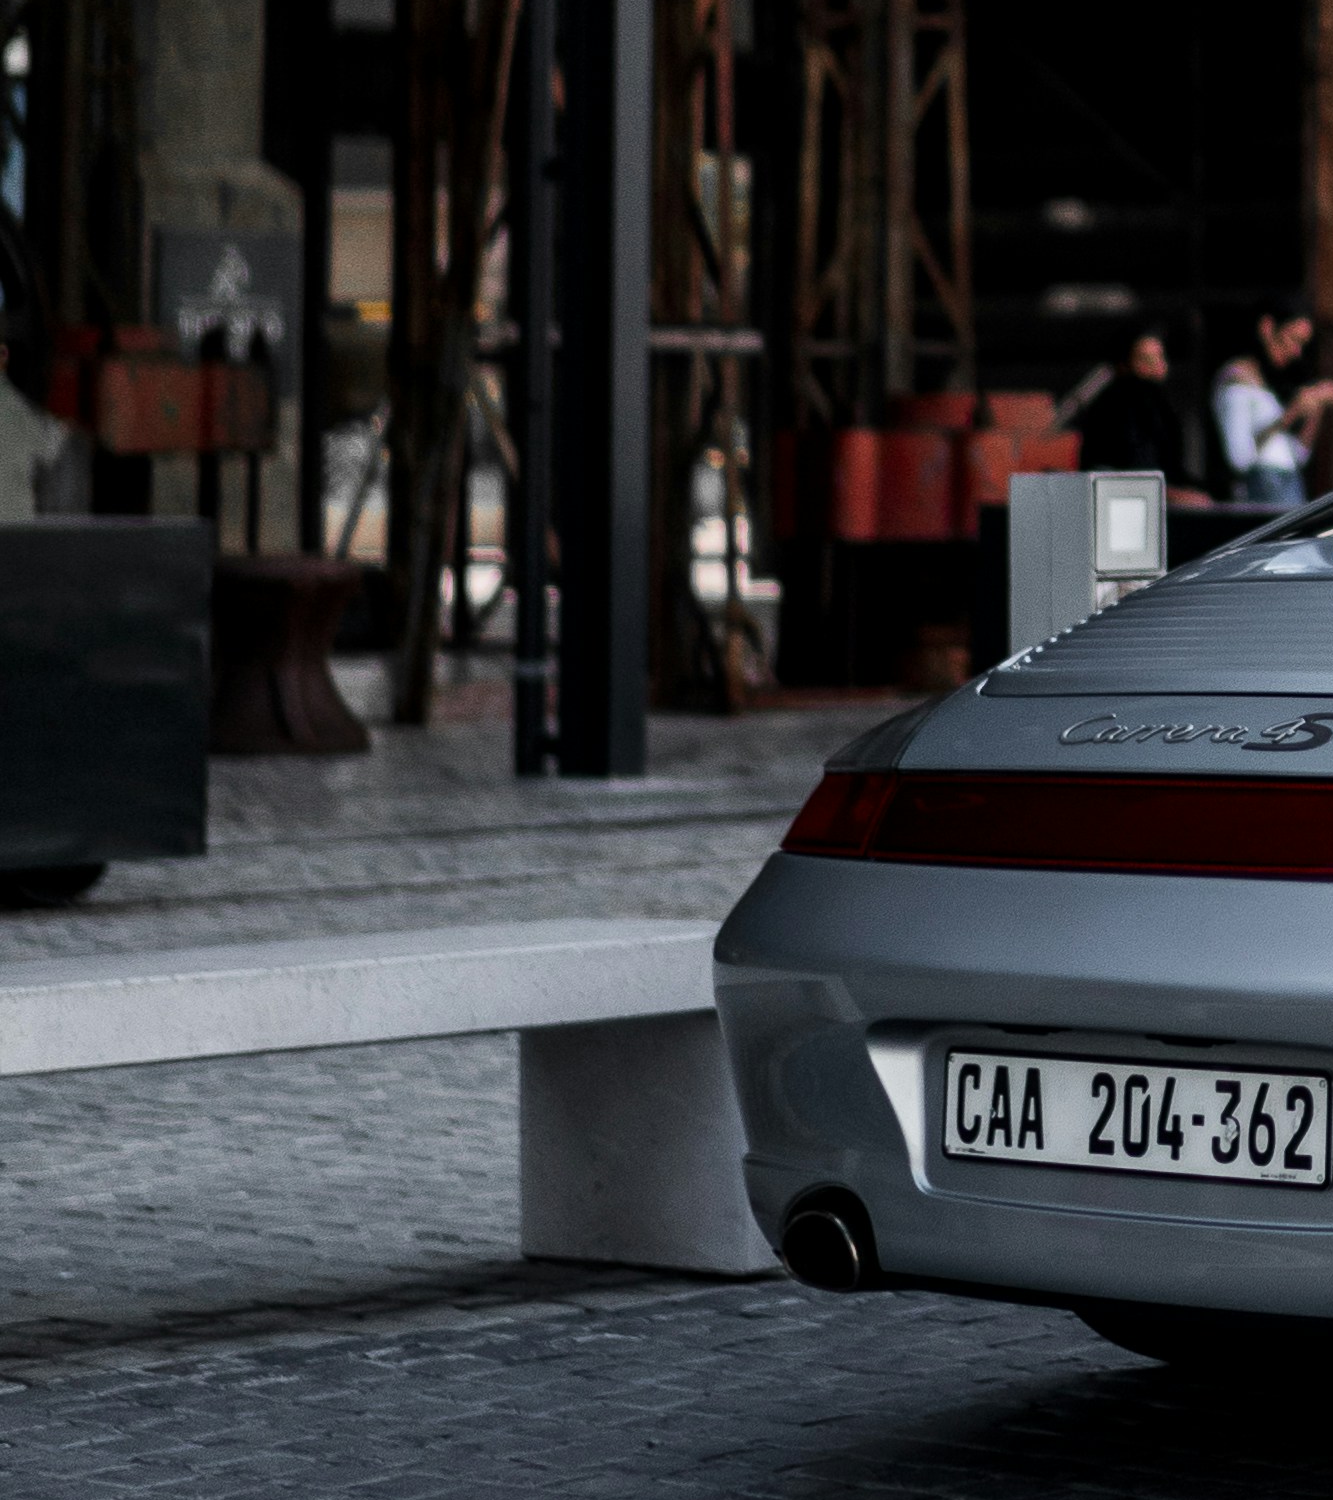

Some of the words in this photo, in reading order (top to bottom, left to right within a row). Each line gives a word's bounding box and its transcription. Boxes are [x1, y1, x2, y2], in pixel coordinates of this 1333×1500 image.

[1059, 713, 1249, 745] Carrera
[956, 1062, 1045, 1151] CAA
[1088, 1071, 1315, 1171] 204-362
